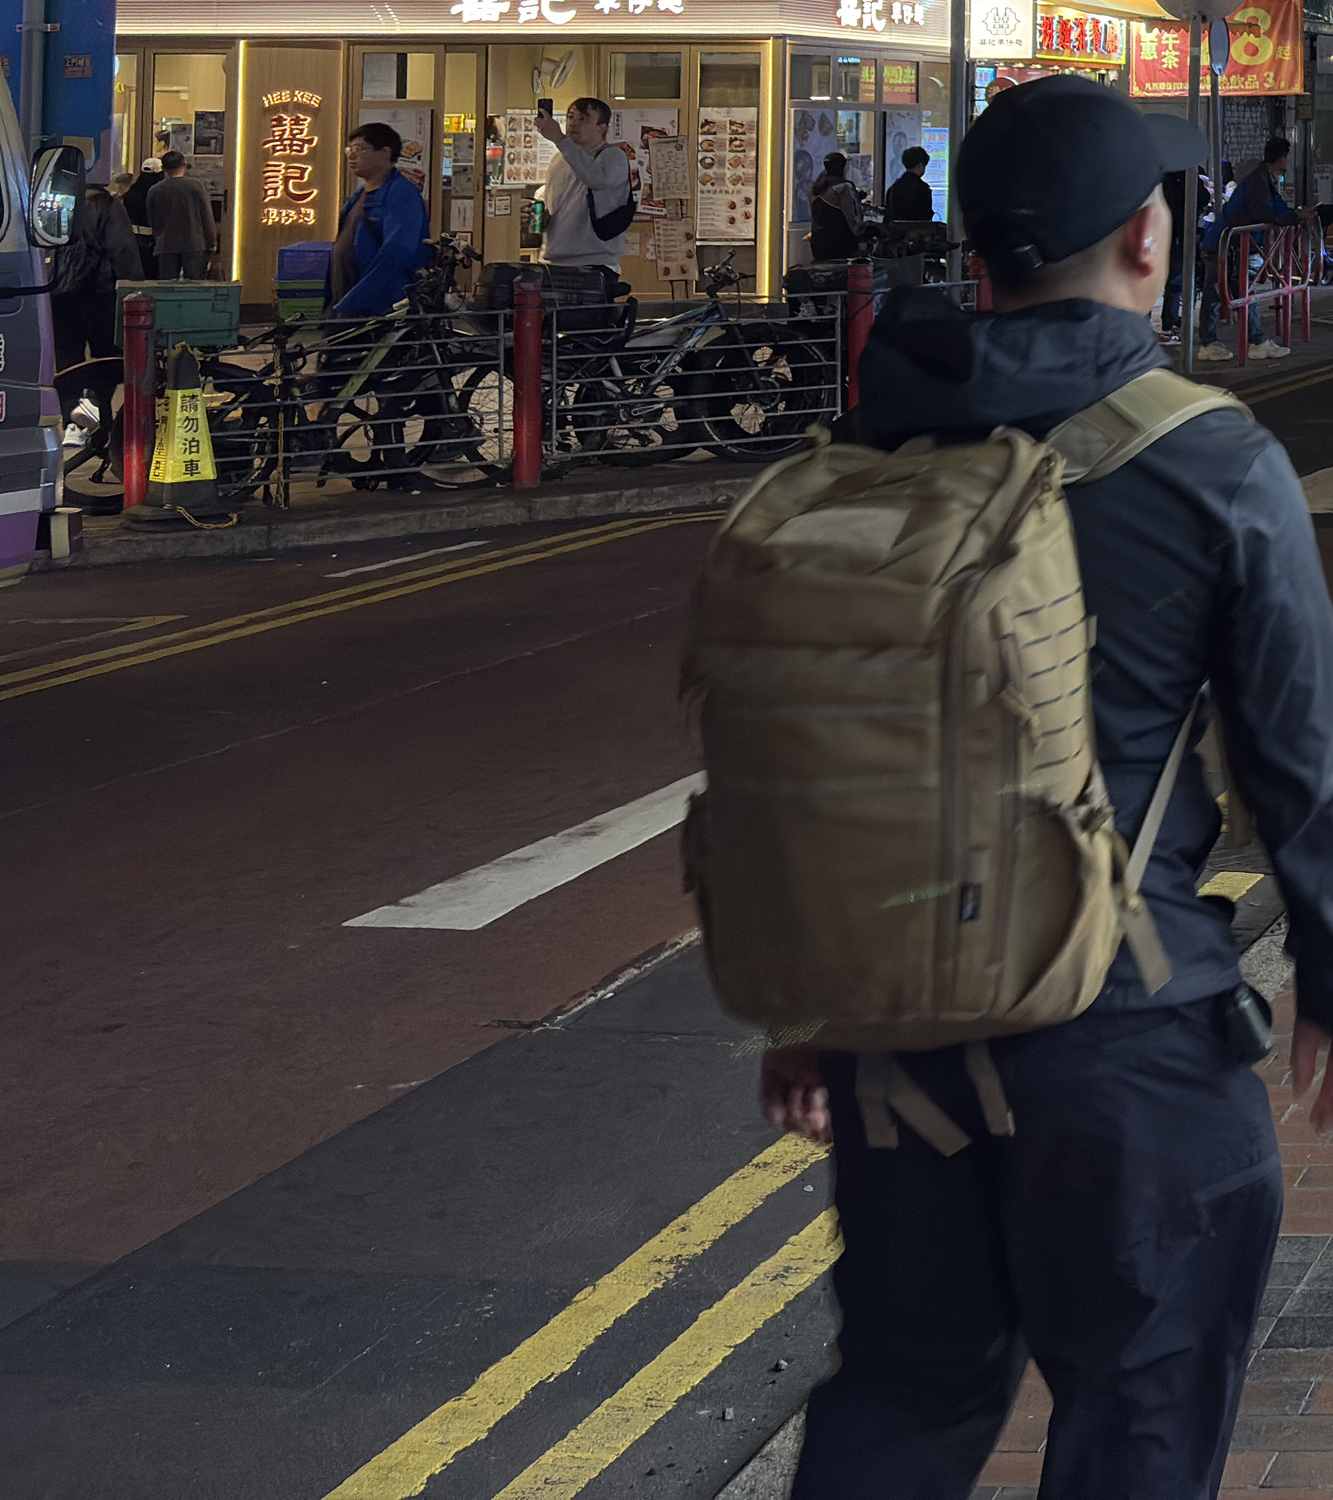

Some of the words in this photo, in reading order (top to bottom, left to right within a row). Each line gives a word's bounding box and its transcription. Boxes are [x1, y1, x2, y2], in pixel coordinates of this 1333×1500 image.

[263, 90, 291, 108] HEE
[293, 90, 323, 108] KEE
[181, 395, 201, 477] 請勿泊車
